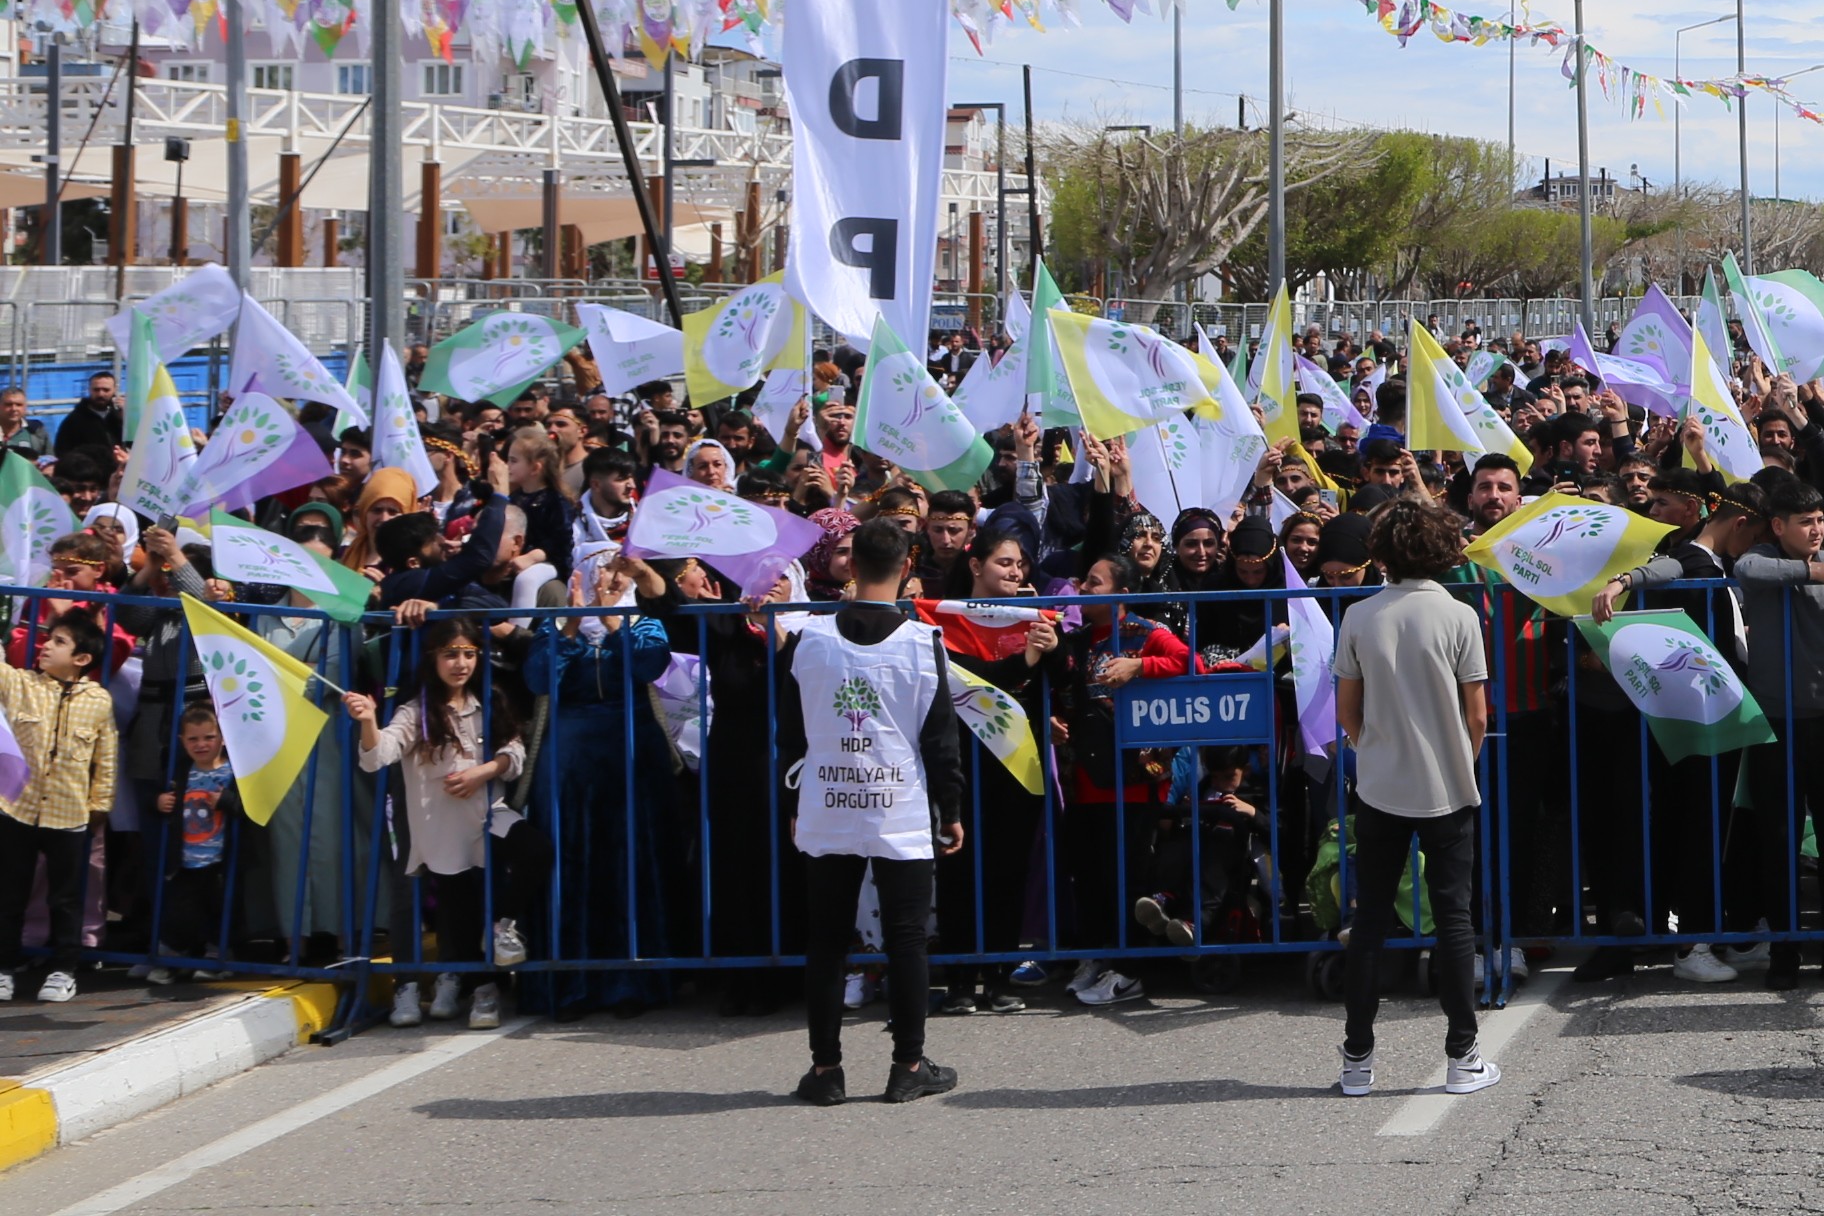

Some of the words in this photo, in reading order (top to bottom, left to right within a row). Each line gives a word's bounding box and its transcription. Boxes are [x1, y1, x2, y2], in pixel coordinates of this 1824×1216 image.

[877, 421, 900, 442] YEŞİL
[900, 437, 917, 453] SOL
[1510, 544, 1534, 568] YEŞİL
[1536, 559, 1553, 577] SOL
[1512, 563, 1541, 585] PARTİ
[1630, 653, 1651, 680] YEŞİL
[1648, 673, 1663, 696] SOL
[1219, 693, 1250, 722] 07
[841, 738, 872, 752] HDP
[818, 766, 885, 784] ANTALYA
[891, 762, 905, 783] İL
[825, 788, 893, 809] ÖRGÜTÜ
